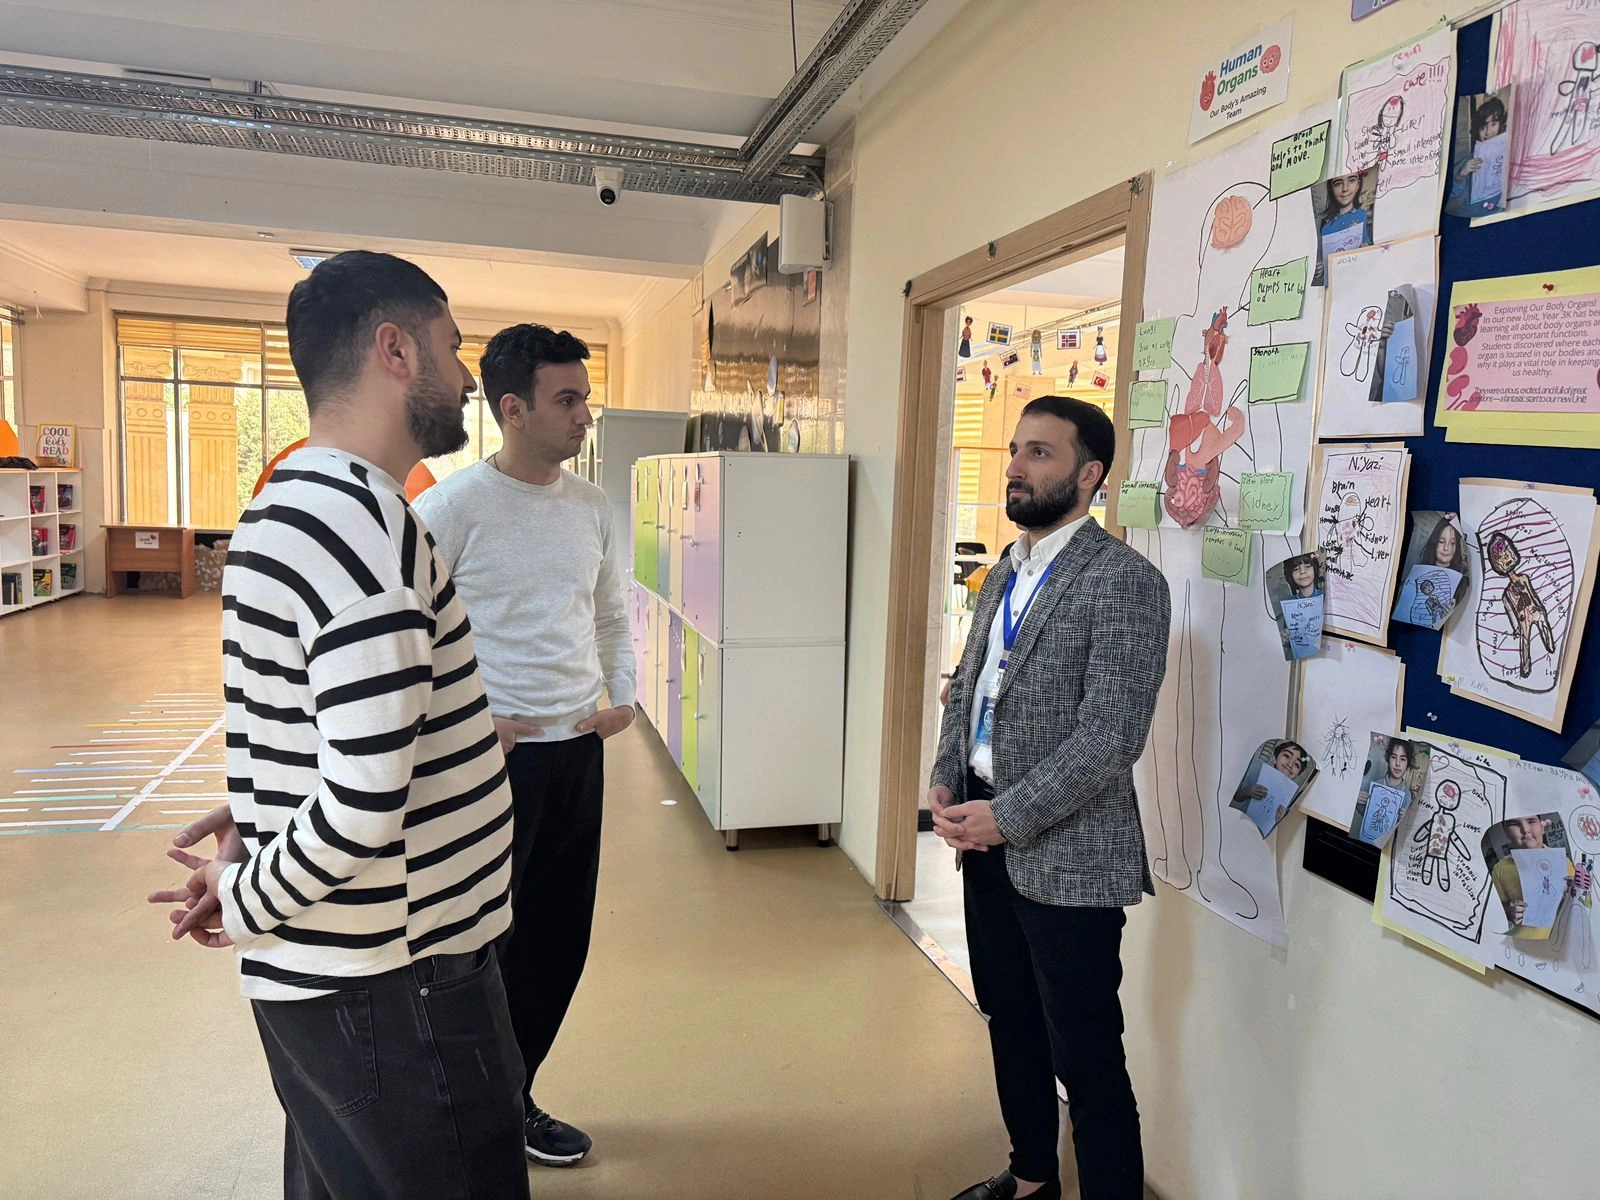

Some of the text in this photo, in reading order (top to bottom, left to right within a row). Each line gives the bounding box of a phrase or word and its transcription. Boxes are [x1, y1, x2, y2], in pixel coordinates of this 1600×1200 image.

[1220, 45, 1262, 78] Human
[1217, 65, 1258, 96] Organs
[1209, 86, 1267, 118] Our Body's Amazing
[1226, 108, 1242, 119] Team
[1495, 299, 1597, 315] Exploring Our Body Organs!
[1573, 309, 1586, 317] has
[1480, 324, 1509, 333] learning
[1511, 323, 1519, 331] all
[1520, 321, 1541, 331] about
[1543, 320, 1563, 330] body
[1565, 319, 1591, 329] organs
[1495, 329, 1589, 341] their important functions.
[1482, 341, 1512, 350] Students
[1513, 339, 1553, 349] discovered
[1555, 339, 1580, 347] where
[1477, 352, 1498, 361] organ
[1499, 351, 1505, 359] is
[1506, 350, 1532, 358] located
[1533, 349, 1541, 357] in
[1558, 348, 1585, 356] bodies
[1477, 362, 1491, 370] why
[1498, 359, 1516, 369] plays
[1524, 358, 1539, 367] vital
[1541, 358, 1556, 367] role
[1558, 358, 1566, 366] in
[1568, 357, 1600, 368] keeping
[1522, 367, 1552, 377] healthy.
[43, 427, 71, 436] COOL
[43, 446, 70, 456] READ
